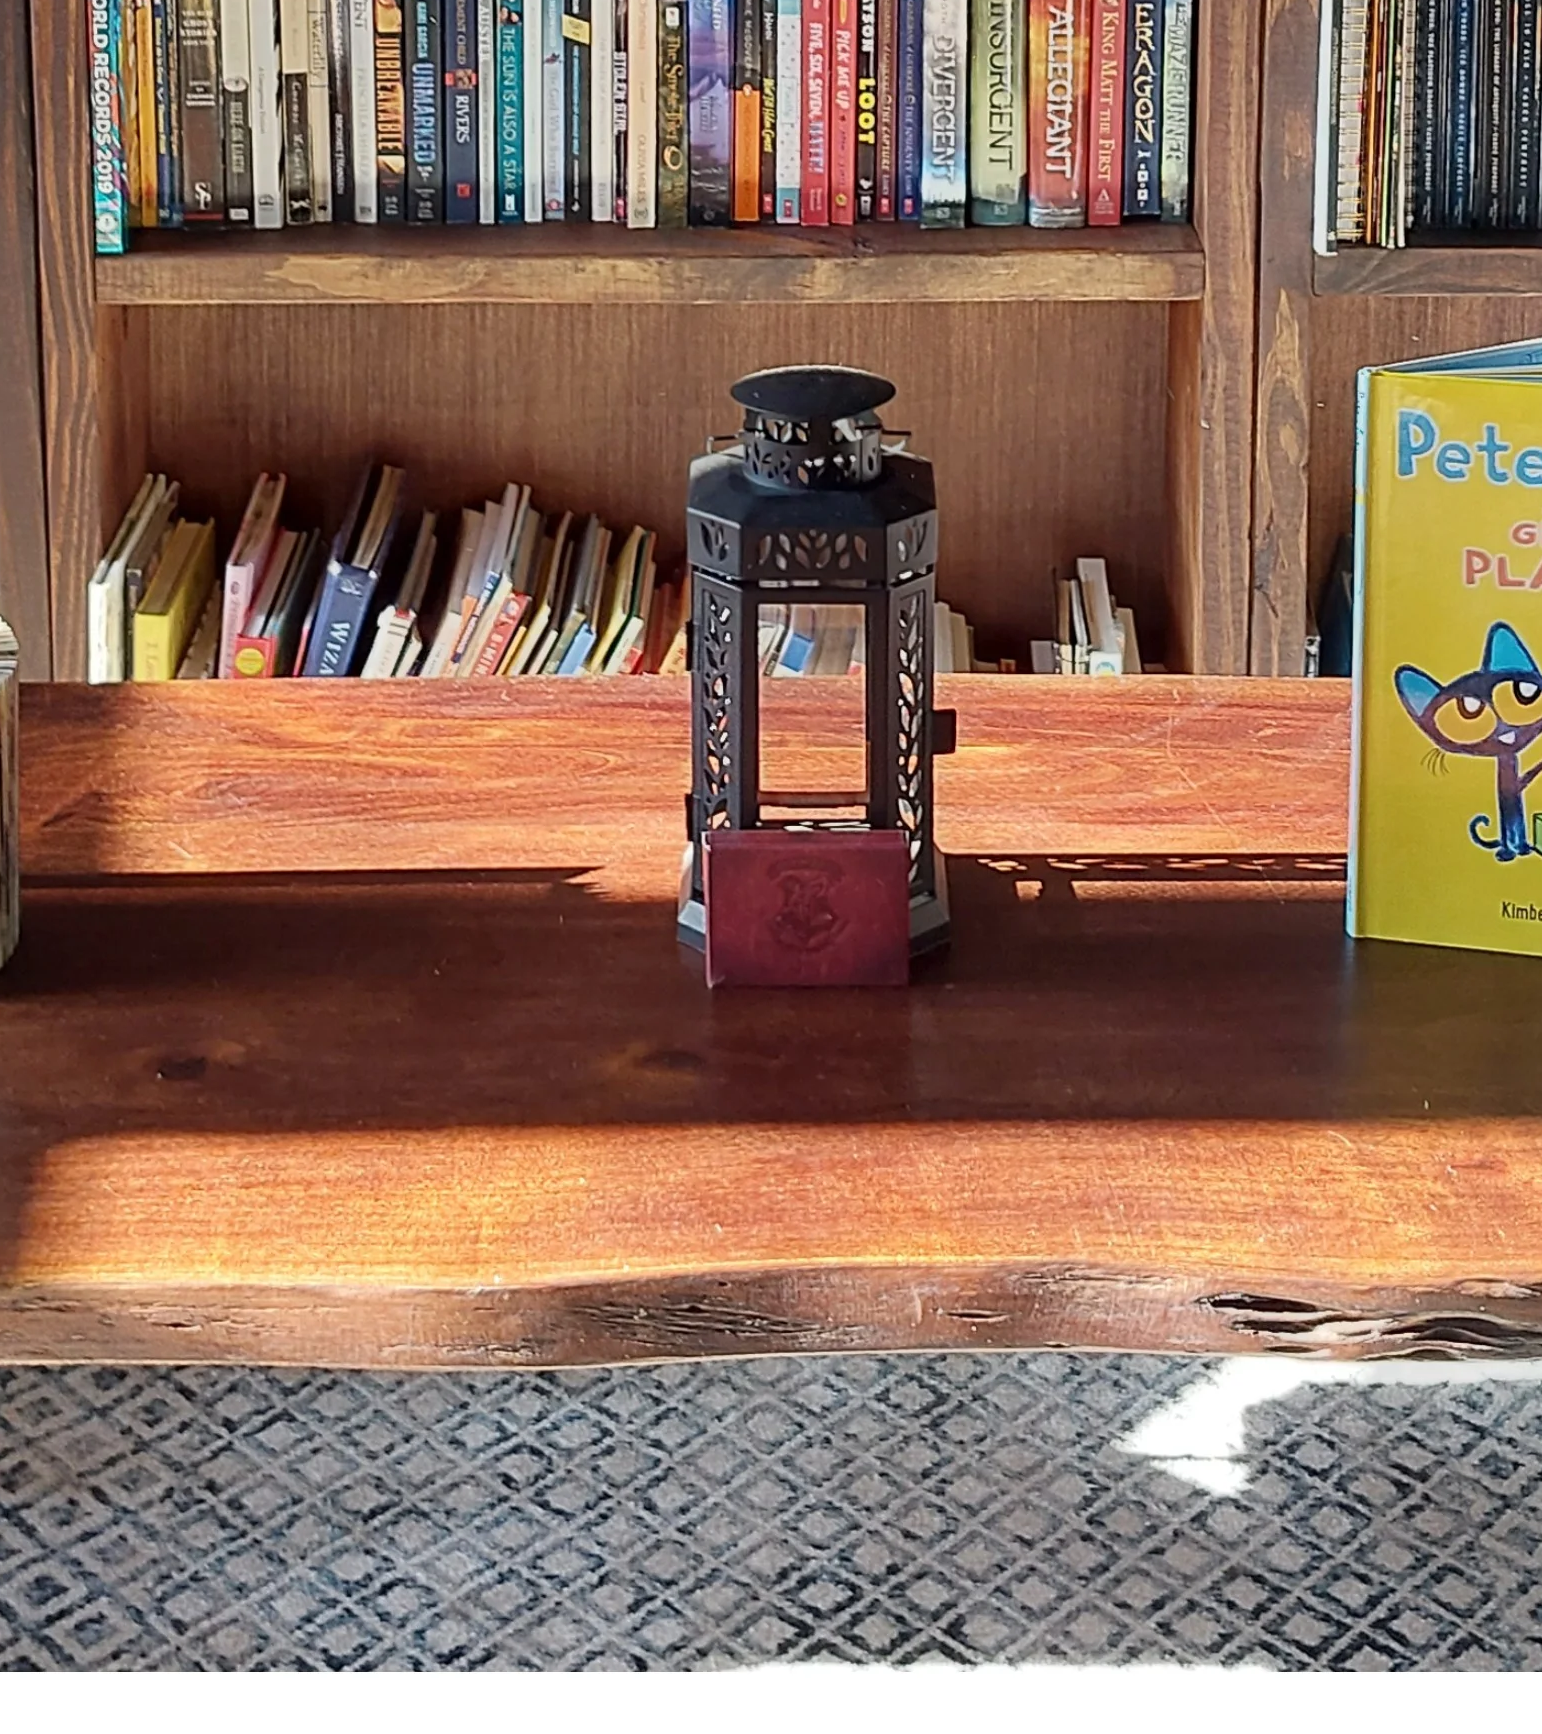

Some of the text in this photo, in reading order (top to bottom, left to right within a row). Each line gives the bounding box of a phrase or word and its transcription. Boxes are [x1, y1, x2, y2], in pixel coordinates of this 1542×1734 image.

[94, 53, 111, 145] RECORDS
[413, 63, 436, 163] UNMARKED
[860, 78, 874, 144] LOOT
[932, 35, 955, 183] DIVERGENT
[989, 1, 1014, 170] INSURGENT
[1047, 6, 1072, 178] ALLEGIANT
[1134, 3, 1155, 142] ERAGON
[96, 150, 112, 193] 2019
